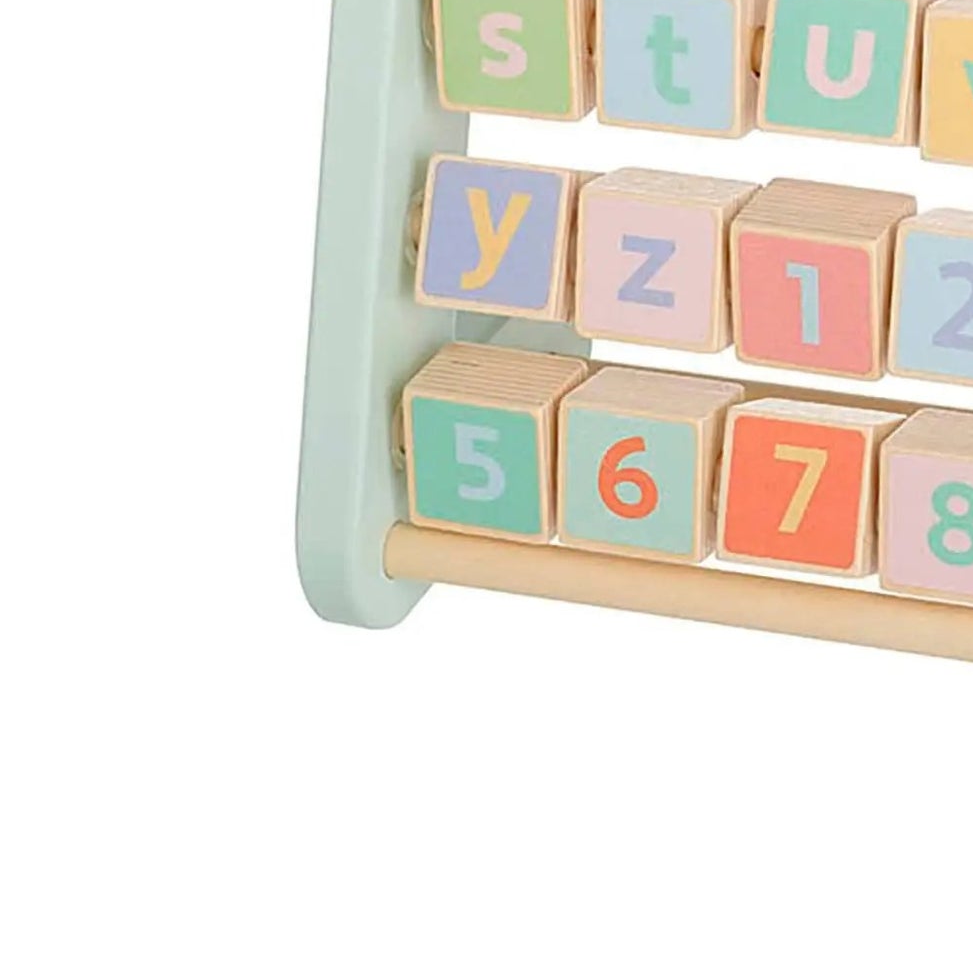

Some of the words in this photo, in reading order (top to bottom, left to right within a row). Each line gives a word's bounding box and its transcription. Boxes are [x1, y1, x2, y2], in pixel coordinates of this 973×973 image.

[479, 12, 528, 78] s
[645, 15, 690, 105] t
[805, 24, 875, 99] u
[460, 187, 531, 290] y
[617, 234, 677, 308] z
[786, 262, 820, 344] 1
[453, 423, 506, 501] 5
[597, 436, 658, 519] 6
[774, 443, 828, 534] 7
